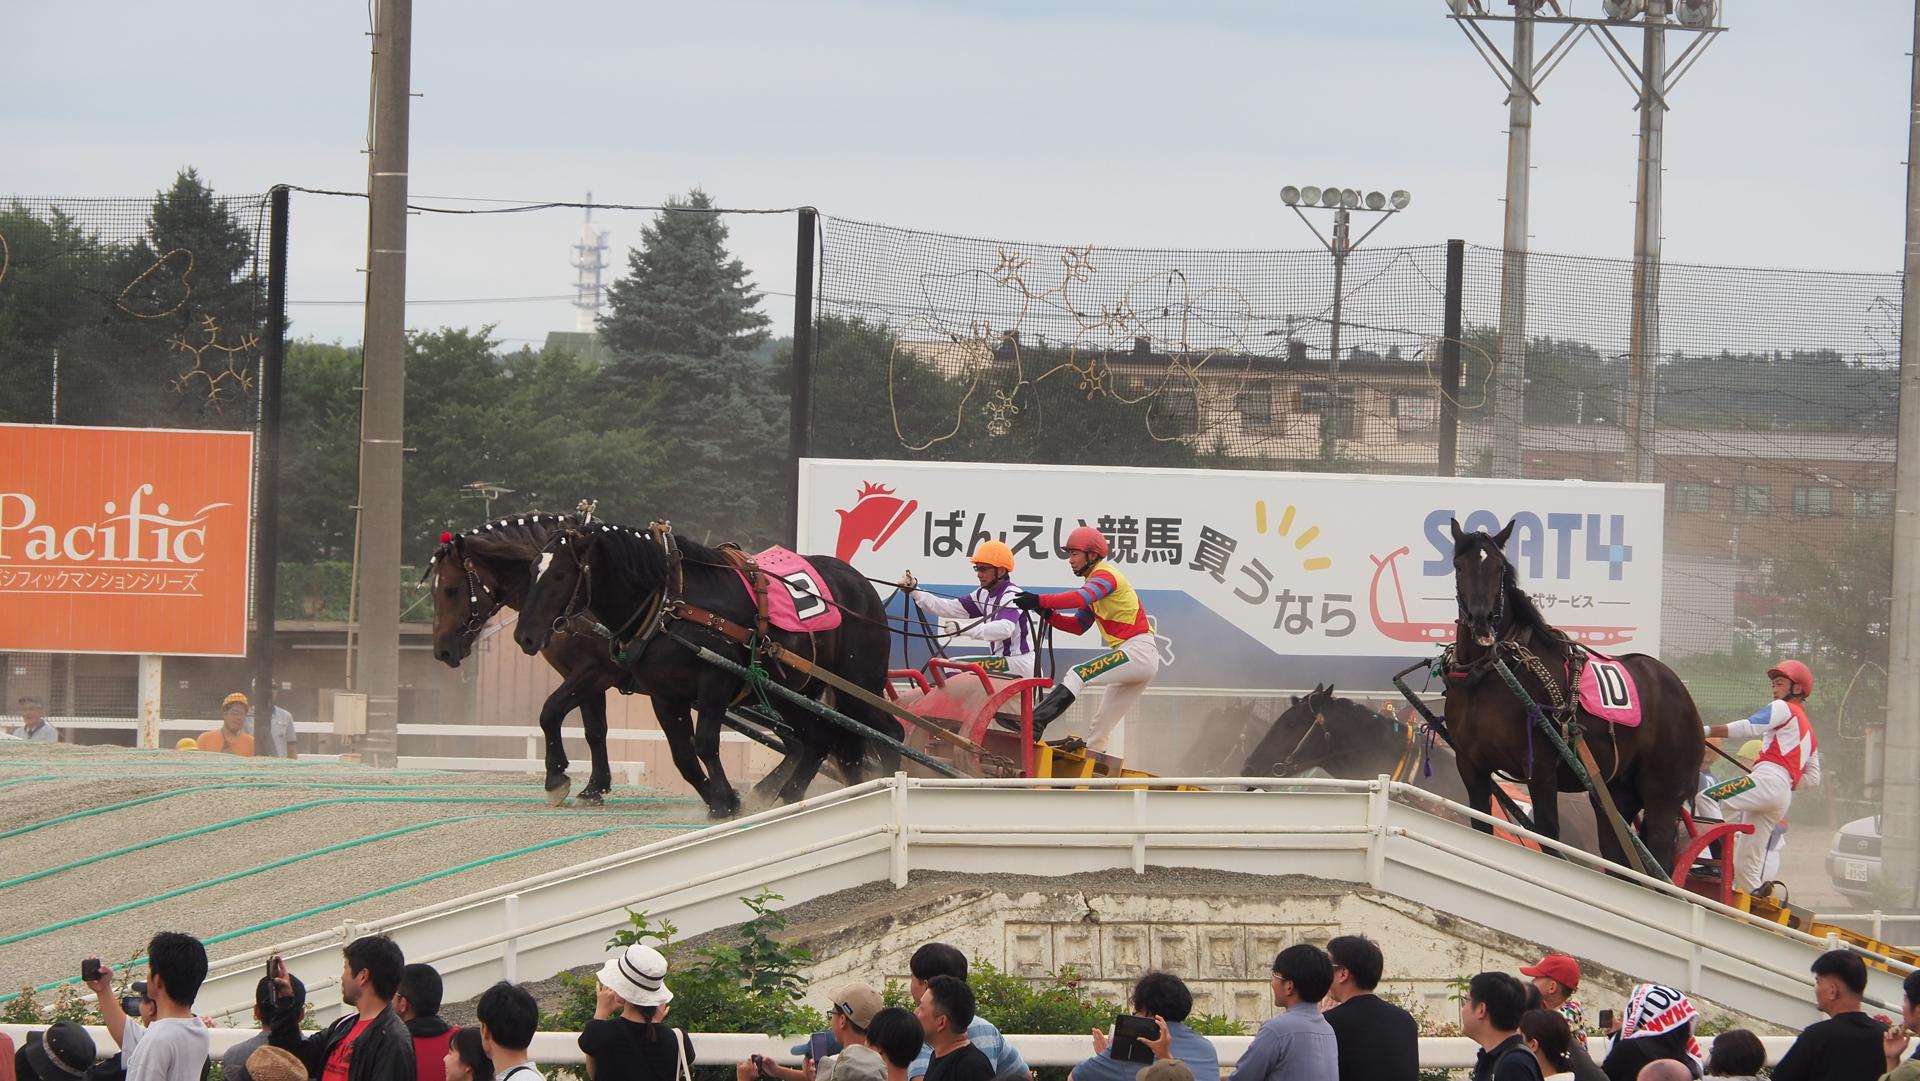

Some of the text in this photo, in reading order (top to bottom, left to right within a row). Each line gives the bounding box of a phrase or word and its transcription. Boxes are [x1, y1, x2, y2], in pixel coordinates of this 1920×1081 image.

[0, 483, 207, 563] Pacific
[924, 509, 1183, 566] ばんえい競馬
[0, 568, 199, 592] シフィックマンションシリーズ
[1591, 663, 1629, 706] 10
